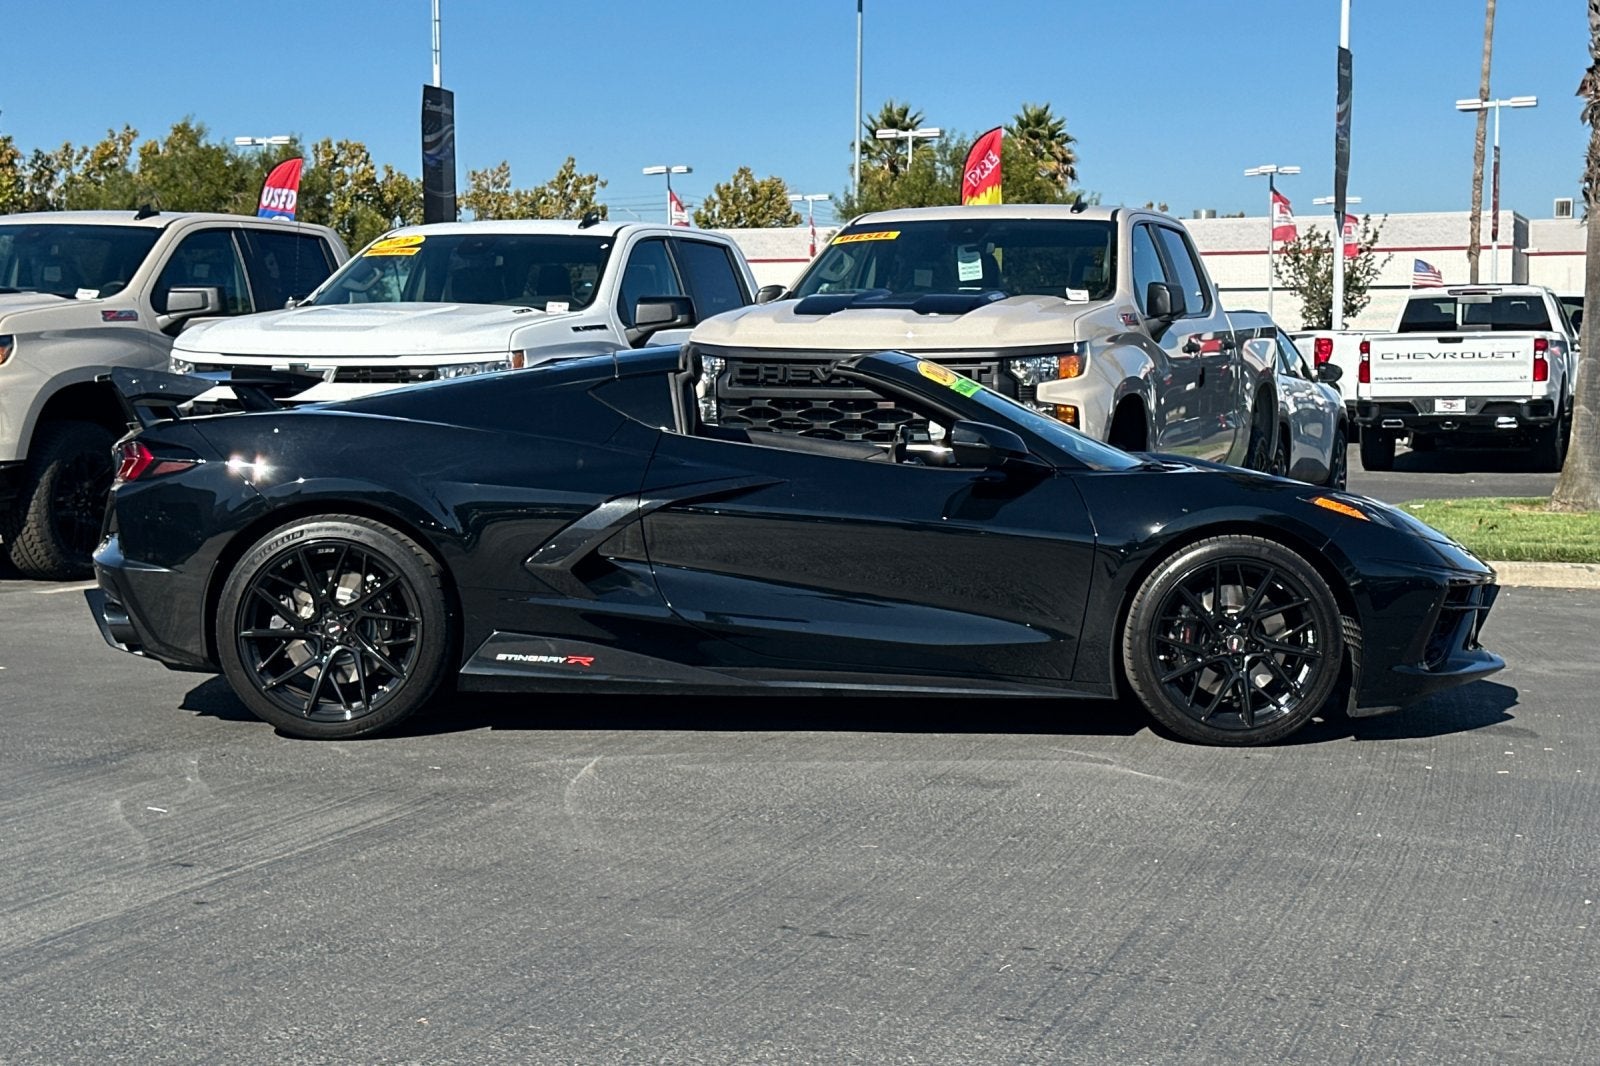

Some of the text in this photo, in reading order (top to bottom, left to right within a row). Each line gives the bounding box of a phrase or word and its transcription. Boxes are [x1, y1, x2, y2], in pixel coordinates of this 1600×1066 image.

[966, 149, 1000, 187] PRE
[261, 186, 297, 210] USED
[839, 232, 891, 242] DIESEL
[1381, 351, 1521, 360] CHEVROLET
[254, 530, 301, 565] MICHELIN
[496, 653, 594, 667] STINGRAY R
